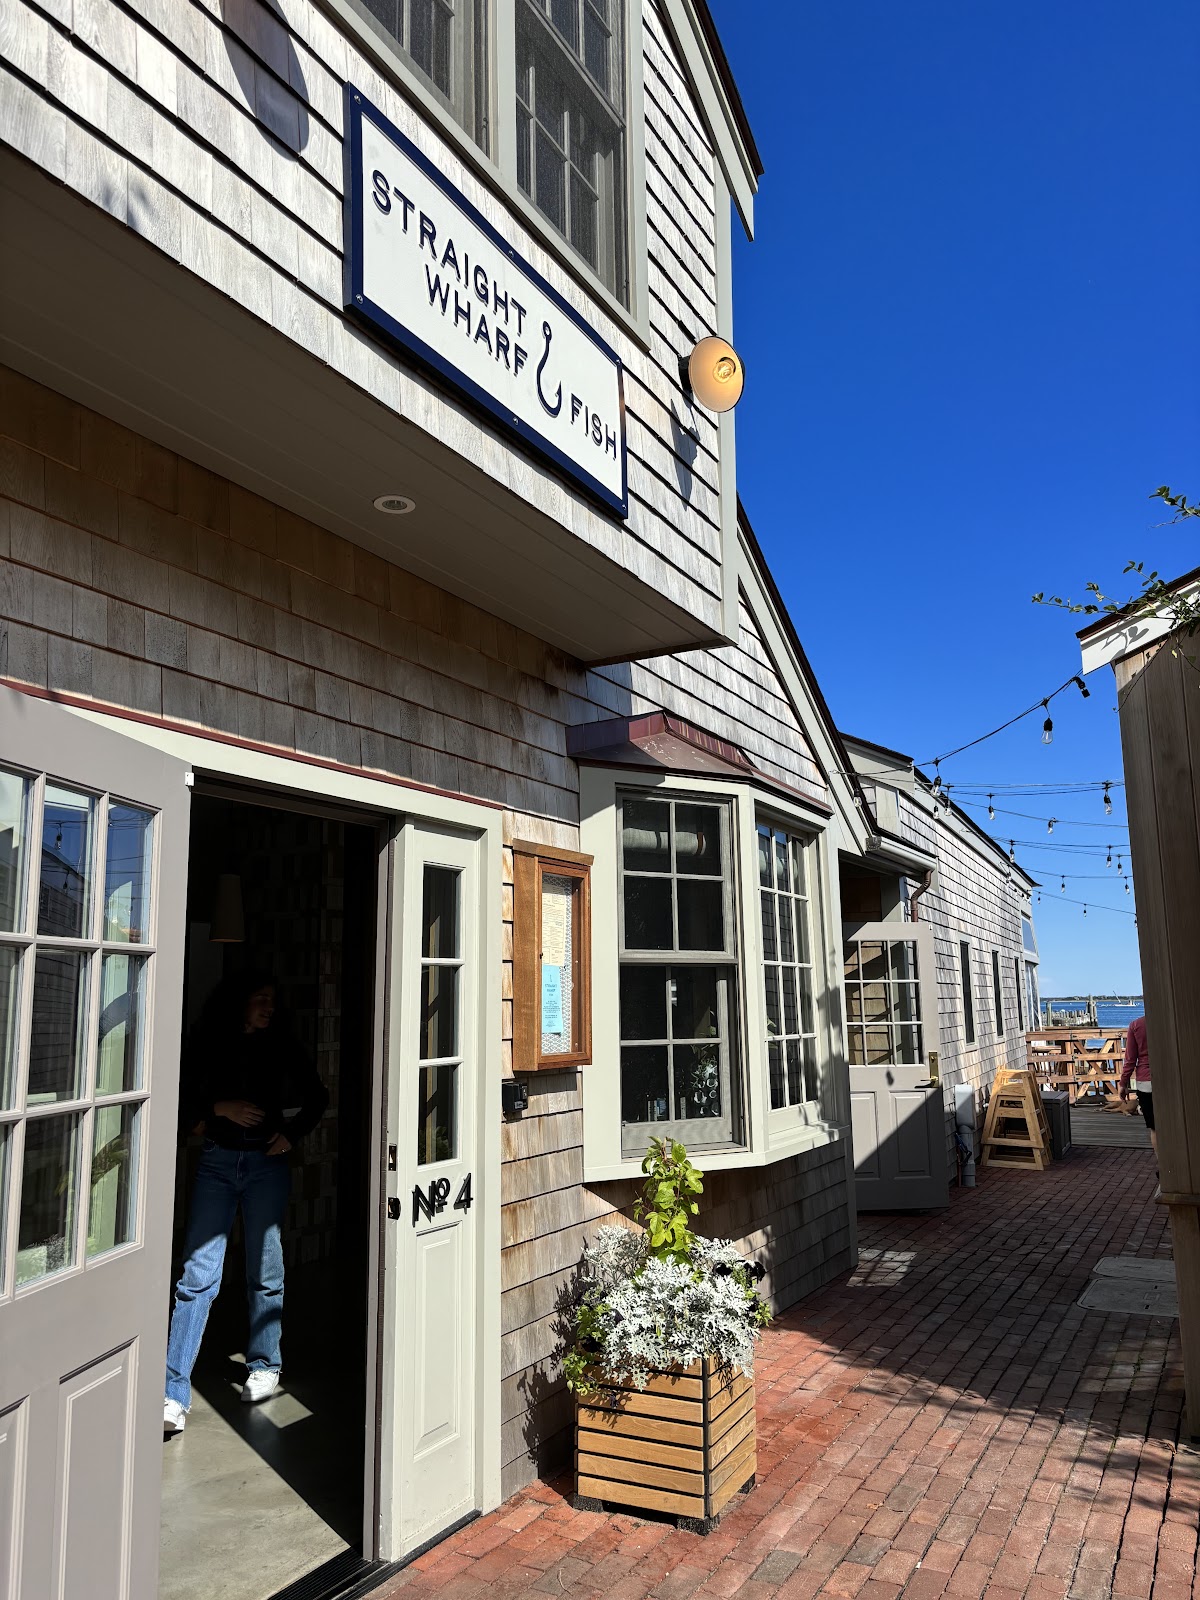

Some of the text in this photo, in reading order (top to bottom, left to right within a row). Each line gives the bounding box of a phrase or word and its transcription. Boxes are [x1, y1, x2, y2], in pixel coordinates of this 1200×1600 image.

[371, 169, 527, 337] STRAIGHT
[424, 263, 528, 376] WHARF
[570, 393, 617, 460] FISH
[453, 1172, 473, 1215] 4
